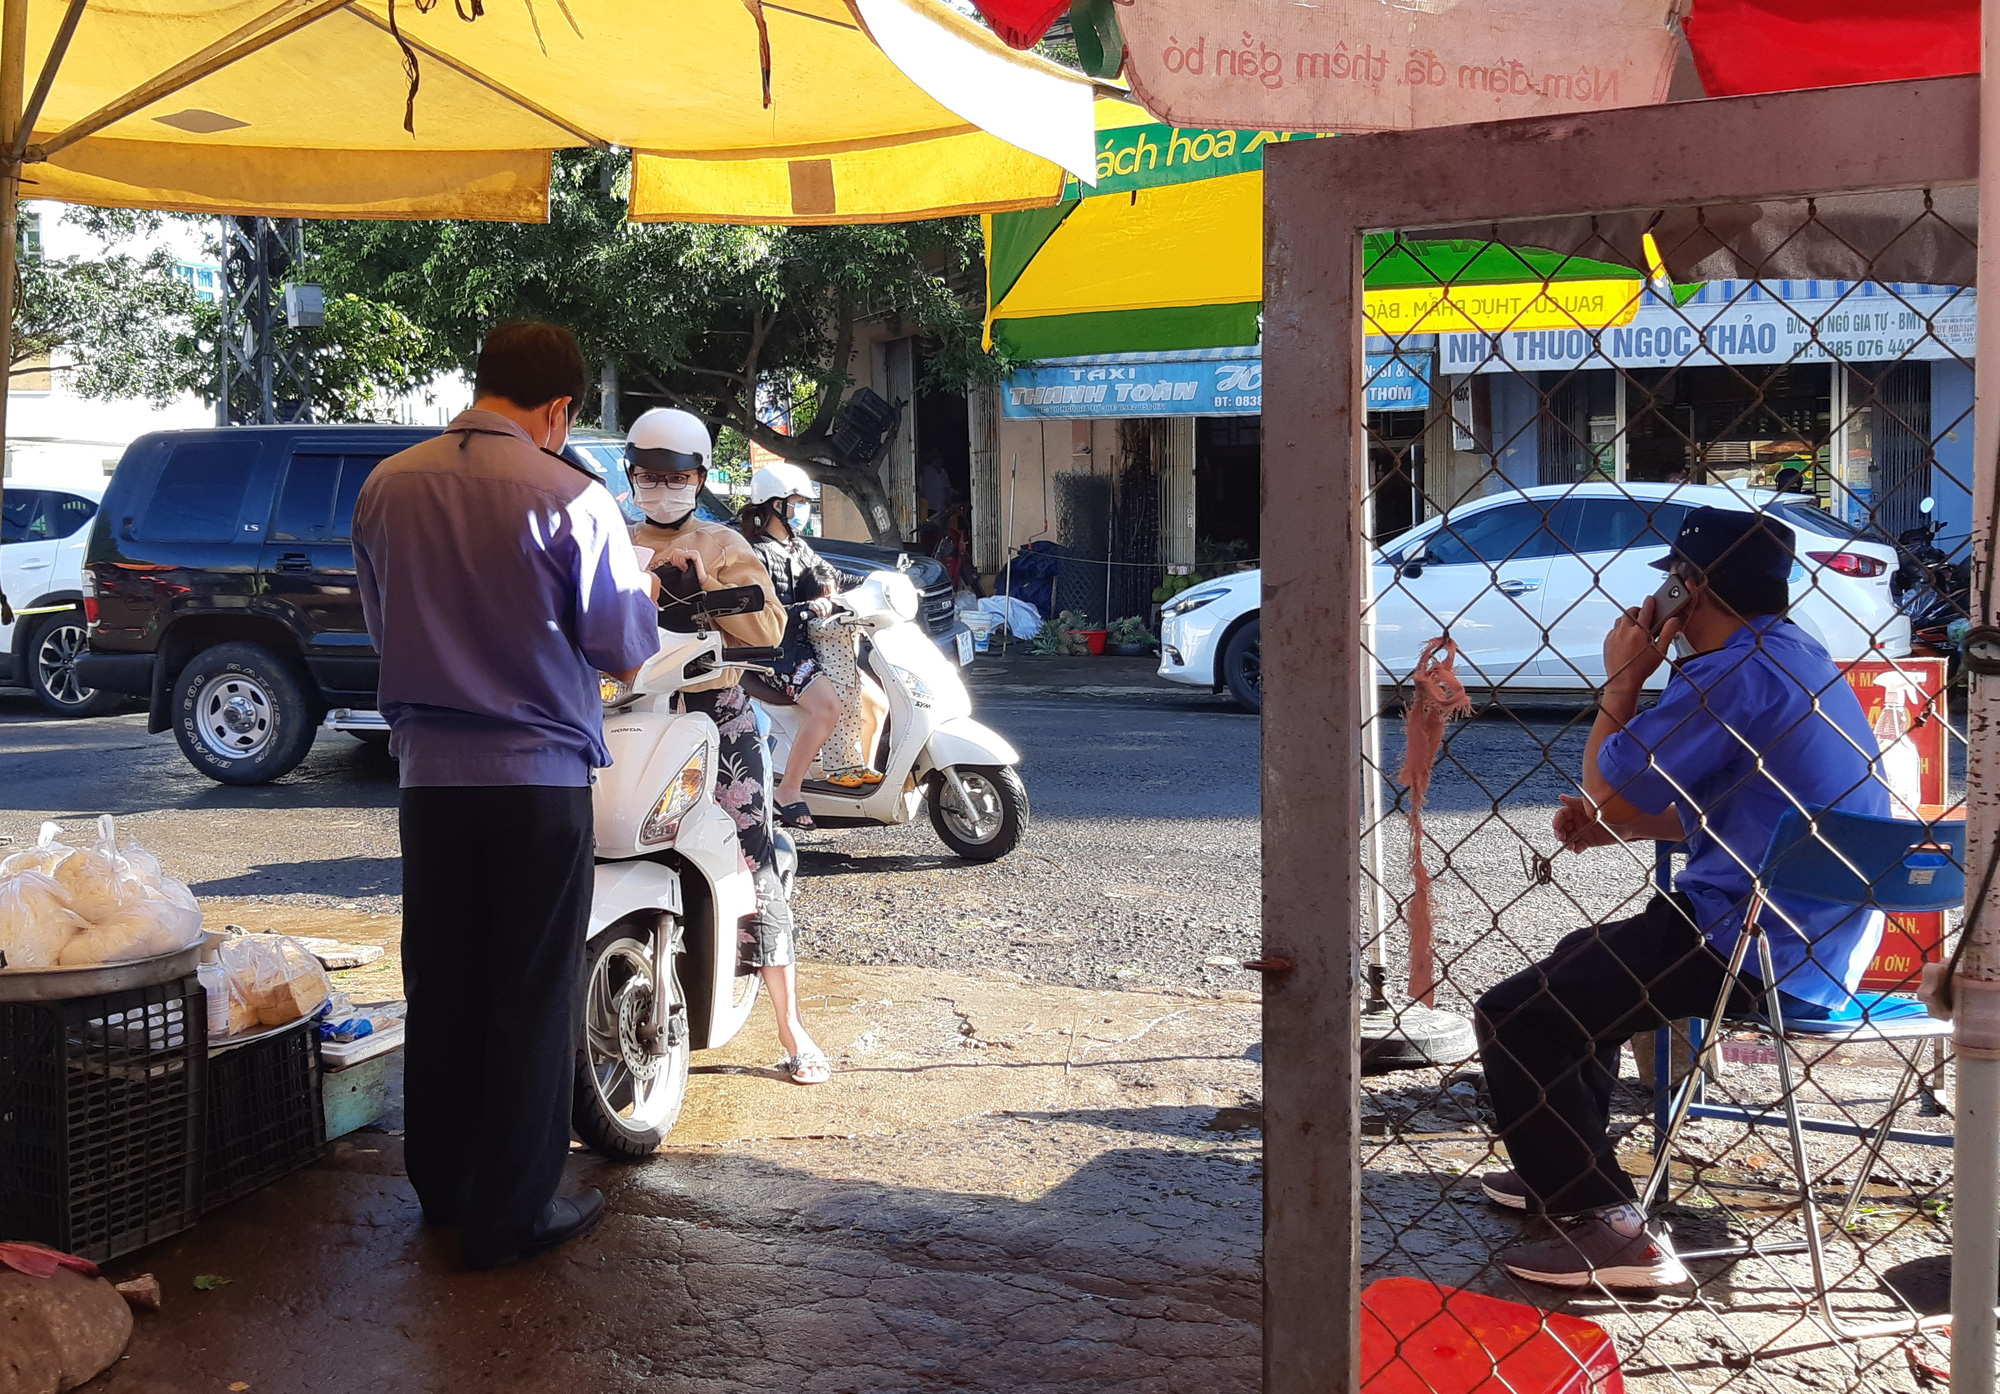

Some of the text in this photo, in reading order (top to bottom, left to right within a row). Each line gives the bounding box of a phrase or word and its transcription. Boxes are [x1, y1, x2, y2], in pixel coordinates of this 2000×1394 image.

[1067, 133, 1158, 184] ách
[1827, 311, 1850, 334] NGÔ
[1853, 314, 1871, 332] GIA
[1875, 311, 1890, 336] TỰ
[1899, 311, 1924, 331] BMT
[1613, 325, 1691, 364] NGỌC
[1701, 314, 1776, 356] THẢO
[1793, 338, 1915, 358] ĐT: 0385 076 442
[1069, 368, 1136, 381] TAXI
[1395, 363, 1404, 378] &
[1009, 379, 1199, 406] THANH TOÀN
[1214, 396, 1232, 408] ĐT:
[1369, 384, 1412, 401] THƠM
[244, 524, 260, 532] LS
[183, 674, 205, 711] 600
[226, 662, 281, 726] MAXXIS
[914, 700, 932, 710] SYM
[1884, 953, 1911, 973] ƠN!
